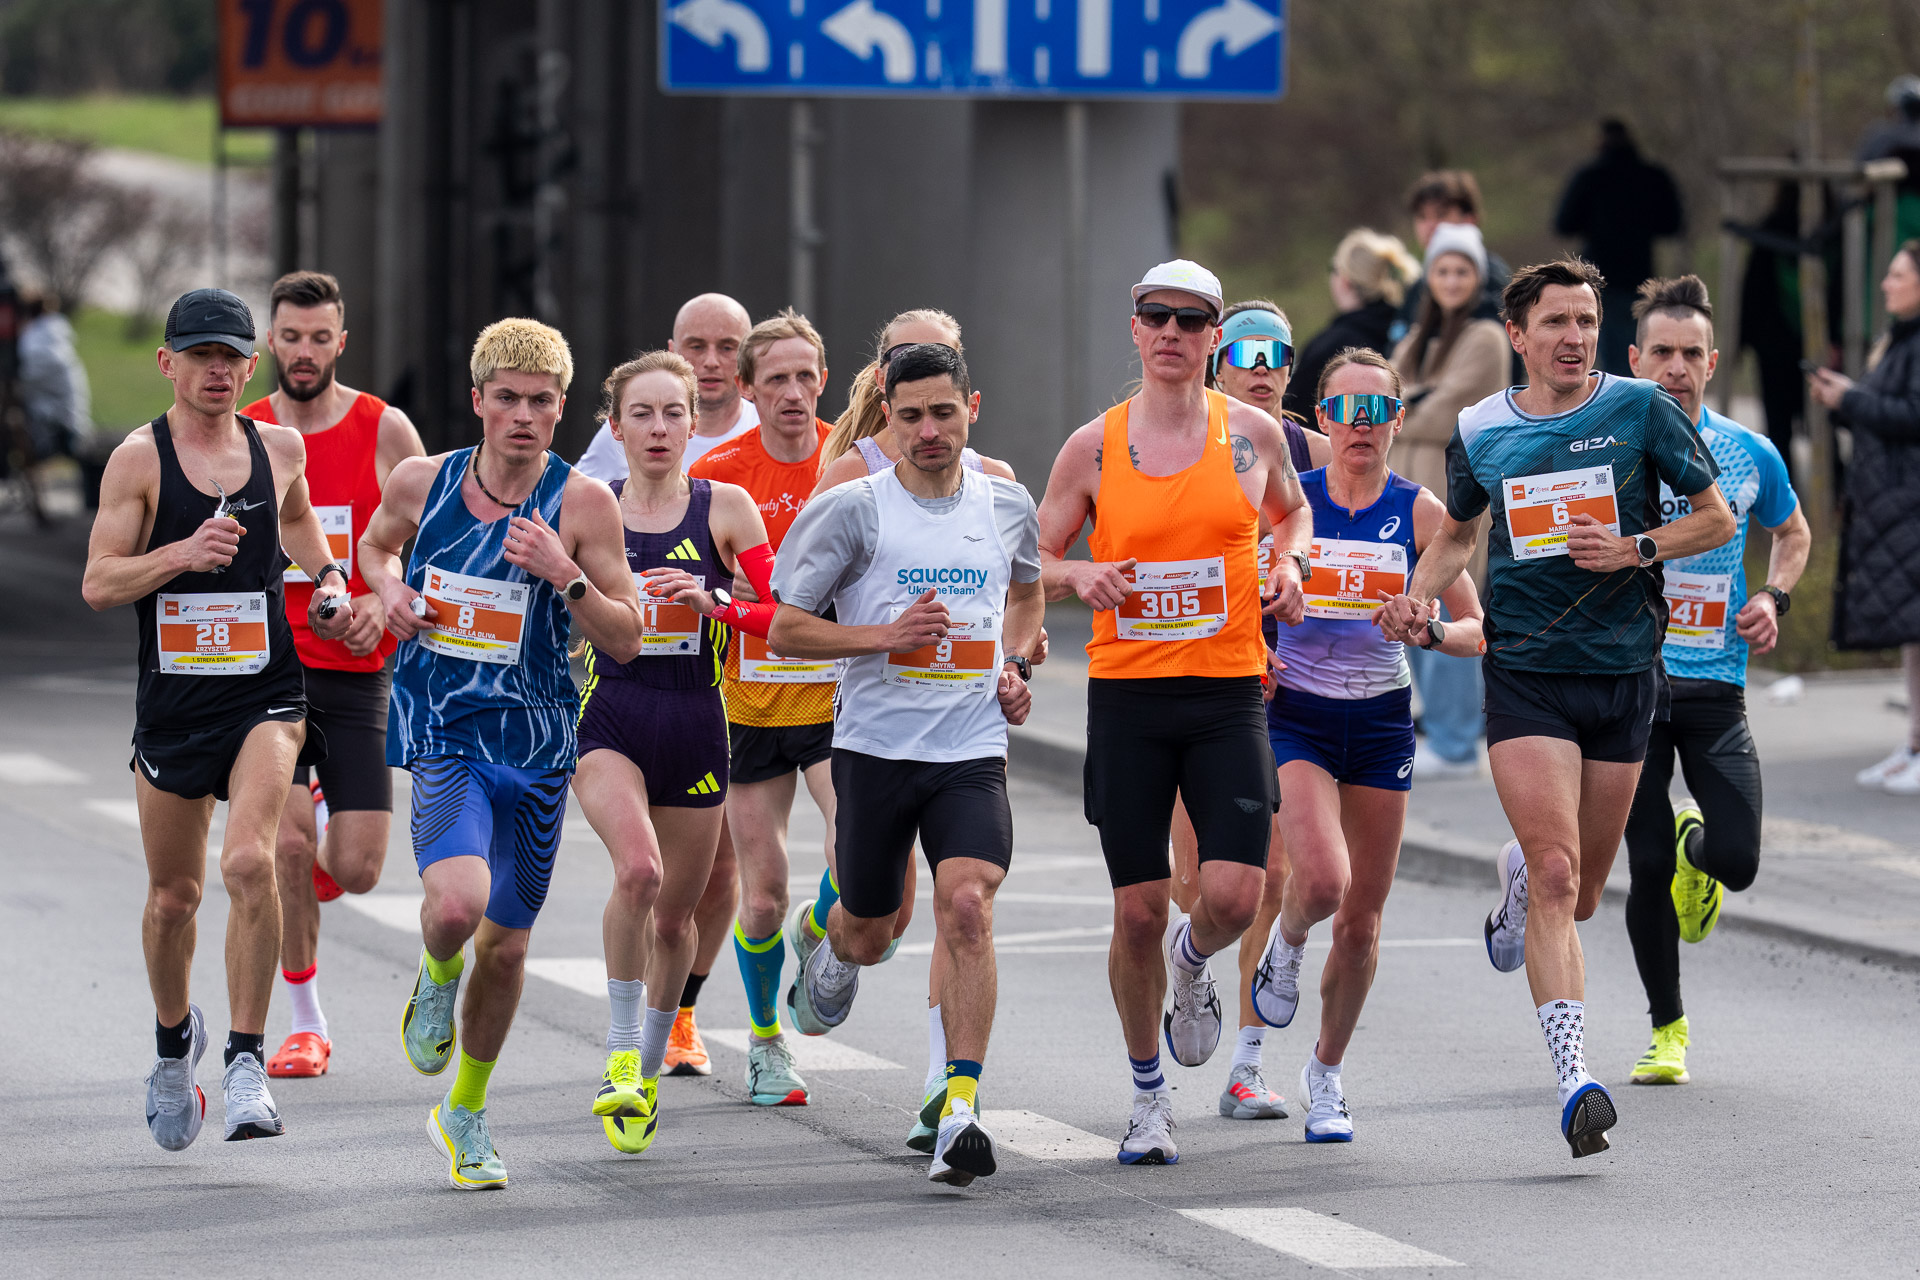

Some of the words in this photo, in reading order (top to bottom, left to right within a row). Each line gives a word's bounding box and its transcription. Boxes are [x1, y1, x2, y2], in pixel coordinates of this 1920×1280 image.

[238, 0, 349, 69] 10
[1570, 435, 1616, 452] GIZA
[1552, 502, 1570, 525] 6
[897, 568, 988, 588] saucony
[1337, 570, 1364, 592] 13
[908, 585, 947, 594] Ukrne
[948, 586, 975, 595] Team
[1140, 590, 1200, 617] 305
[457, 606, 475, 629] 8
[196, 623, 229, 645] 28
[436, 623, 457, 633] MILLAN
[478, 631, 496, 639] OLIVA
[936, 640, 952, 662] 9
